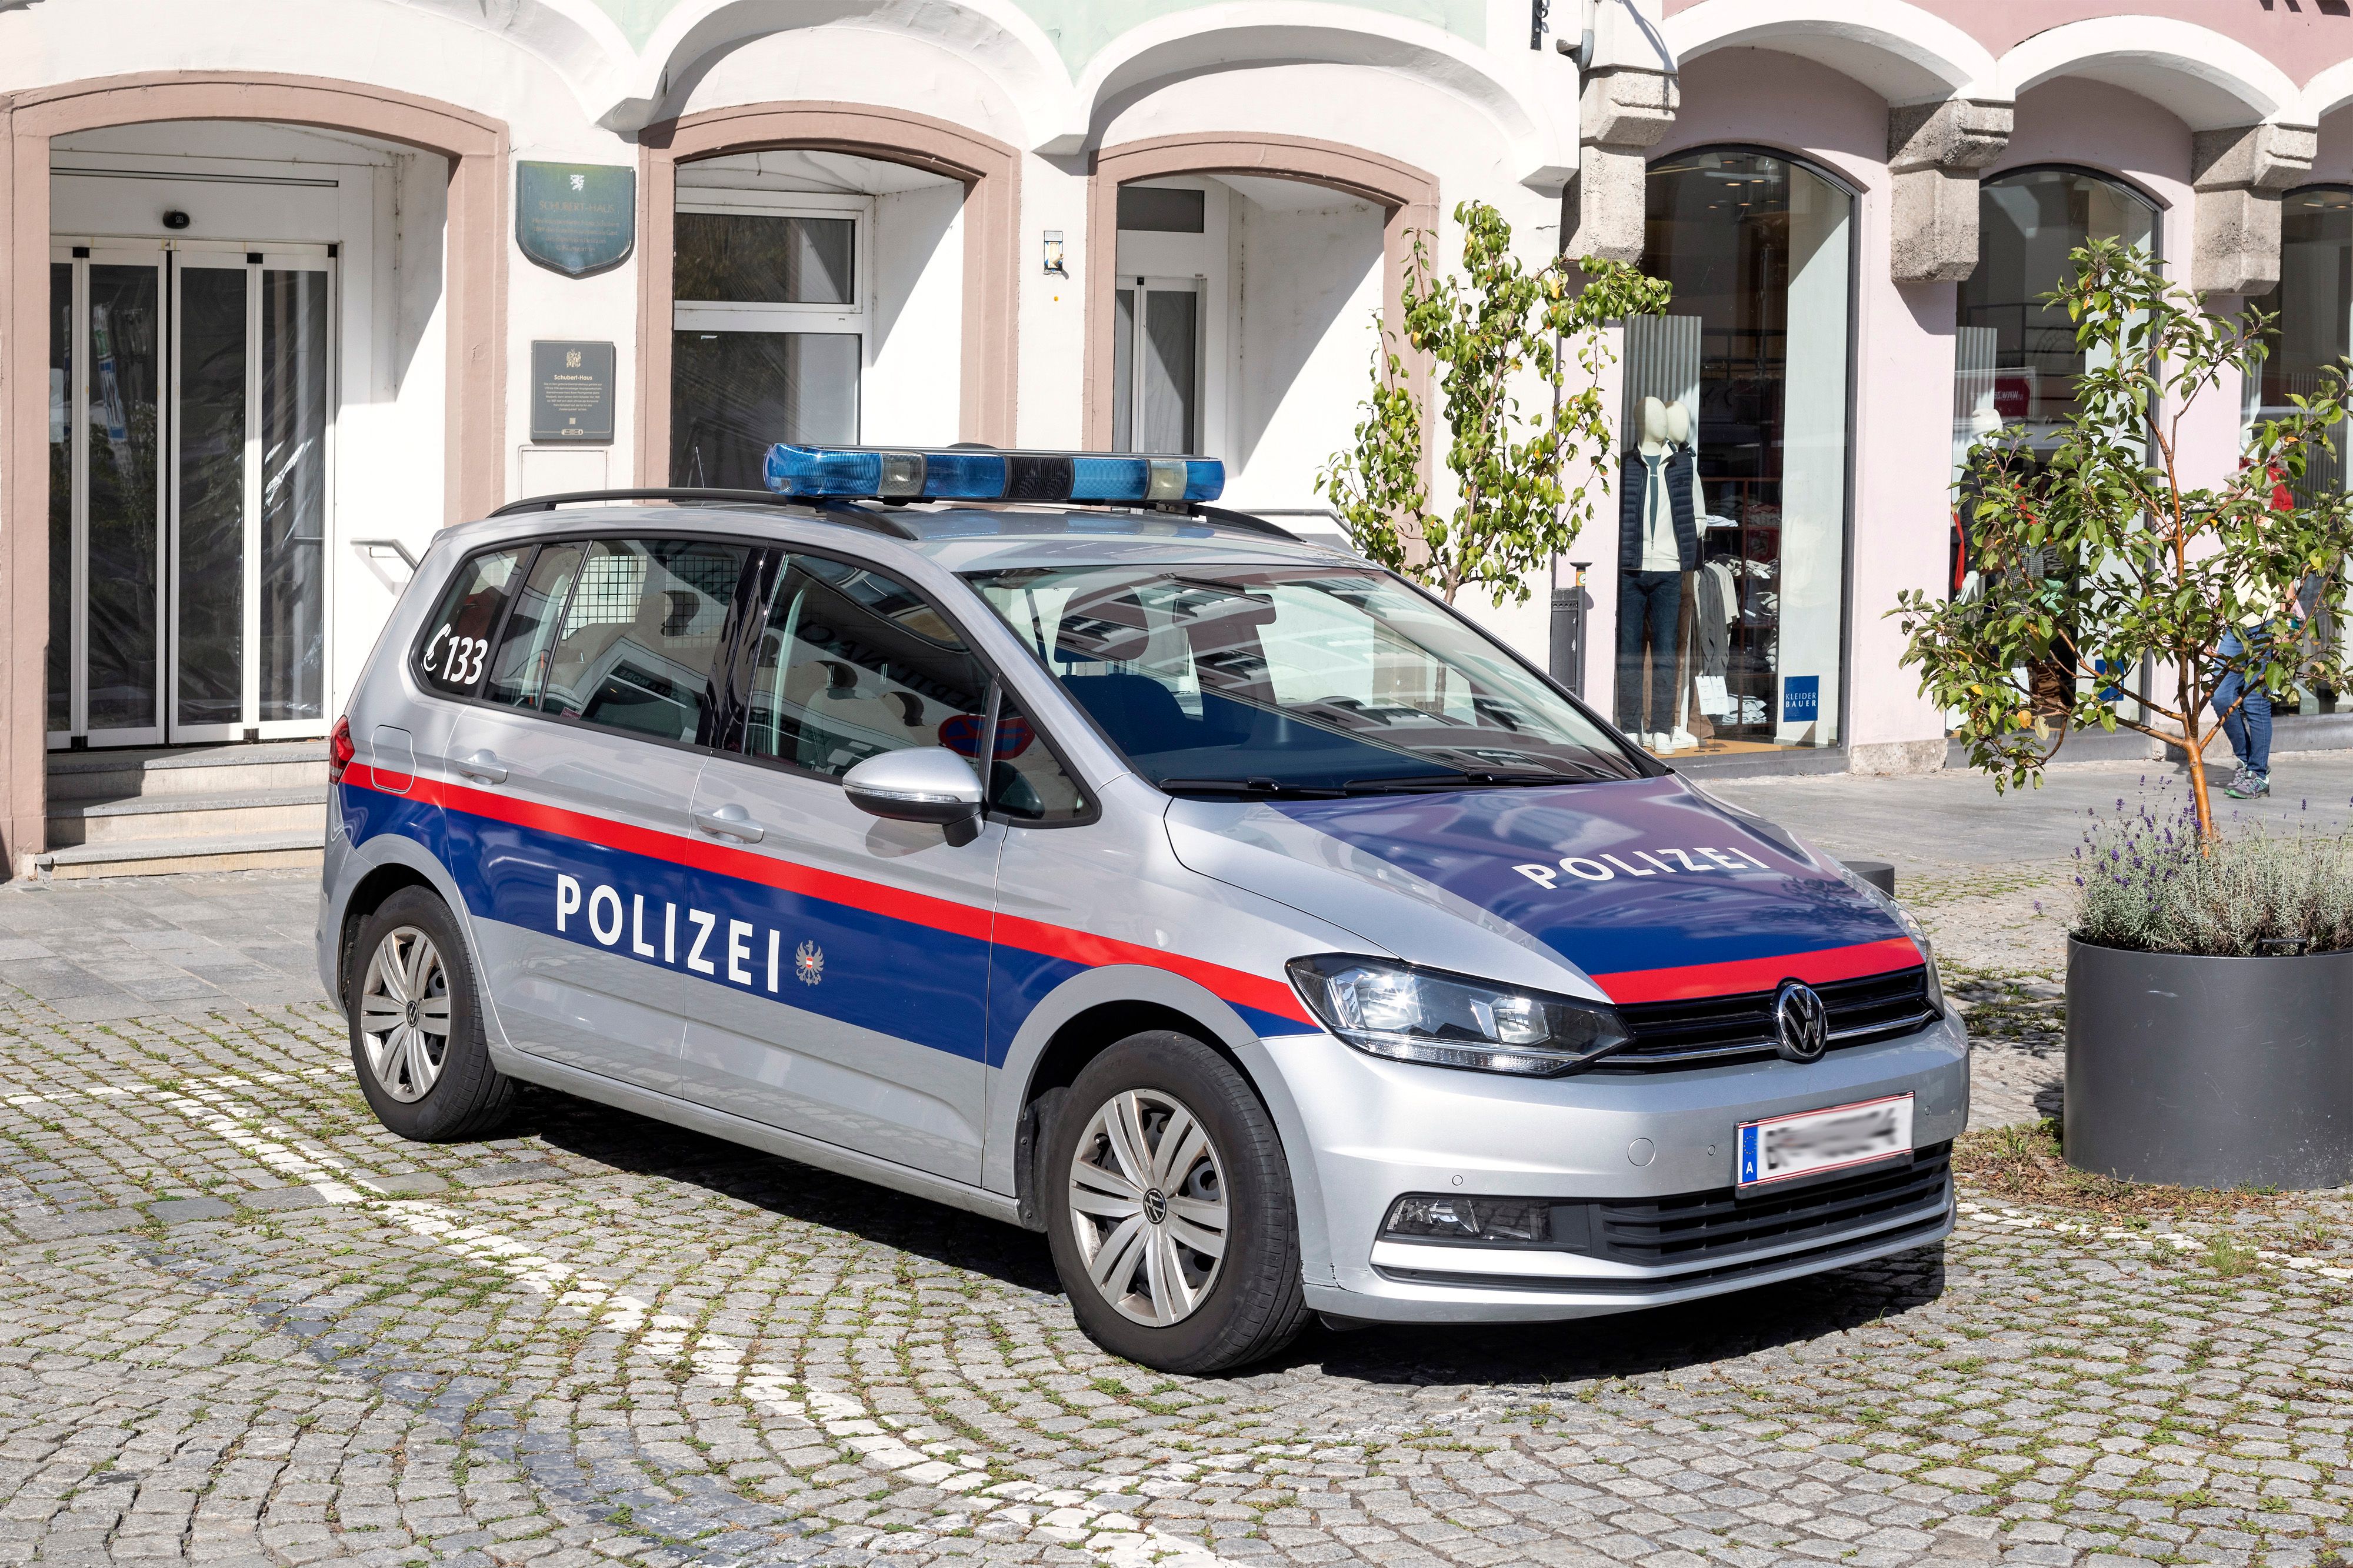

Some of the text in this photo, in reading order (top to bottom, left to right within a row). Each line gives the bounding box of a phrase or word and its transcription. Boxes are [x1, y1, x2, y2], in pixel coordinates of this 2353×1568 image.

[442, 636, 488, 685] 133
[1511, 848, 1771, 889] POLIZEI
[556, 873, 780, 993] POLIZEI
[1746, 1162, 1753, 1174] A
